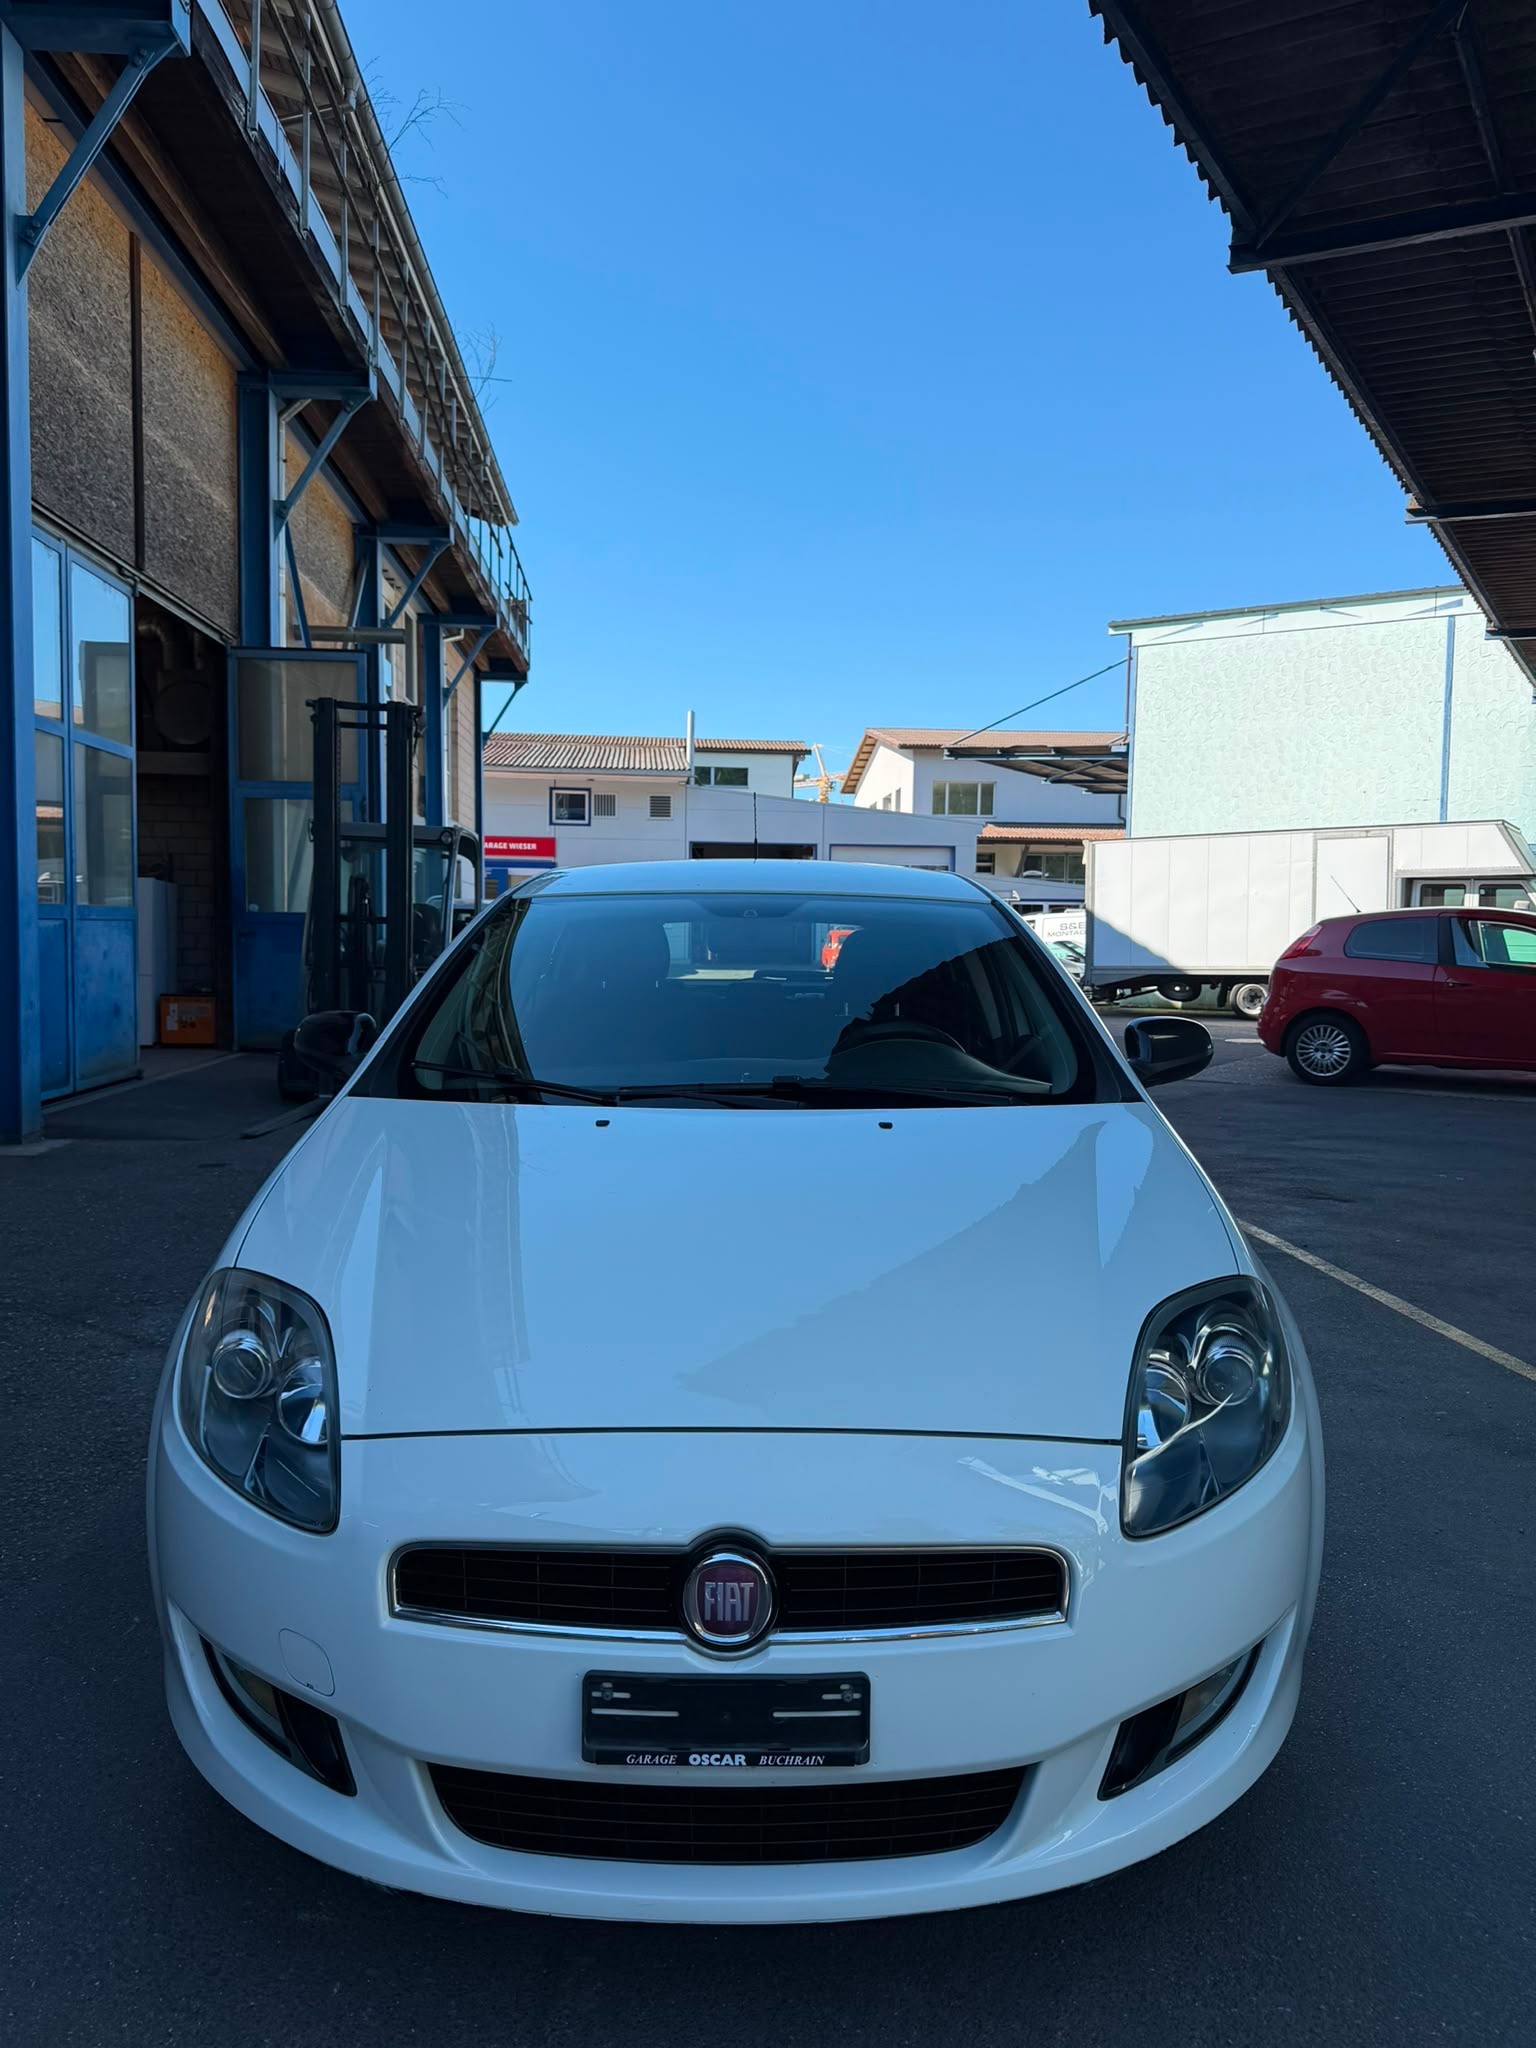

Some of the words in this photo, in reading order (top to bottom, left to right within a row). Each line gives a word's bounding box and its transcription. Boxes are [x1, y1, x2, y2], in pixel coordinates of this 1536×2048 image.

[704, 1582, 754, 1621] FIAT
[626, 1754, 677, 1765] GARAGE
[689, 1753, 746, 1766] OSCAR
[759, 1755, 825, 1765] BUCHRAIN
